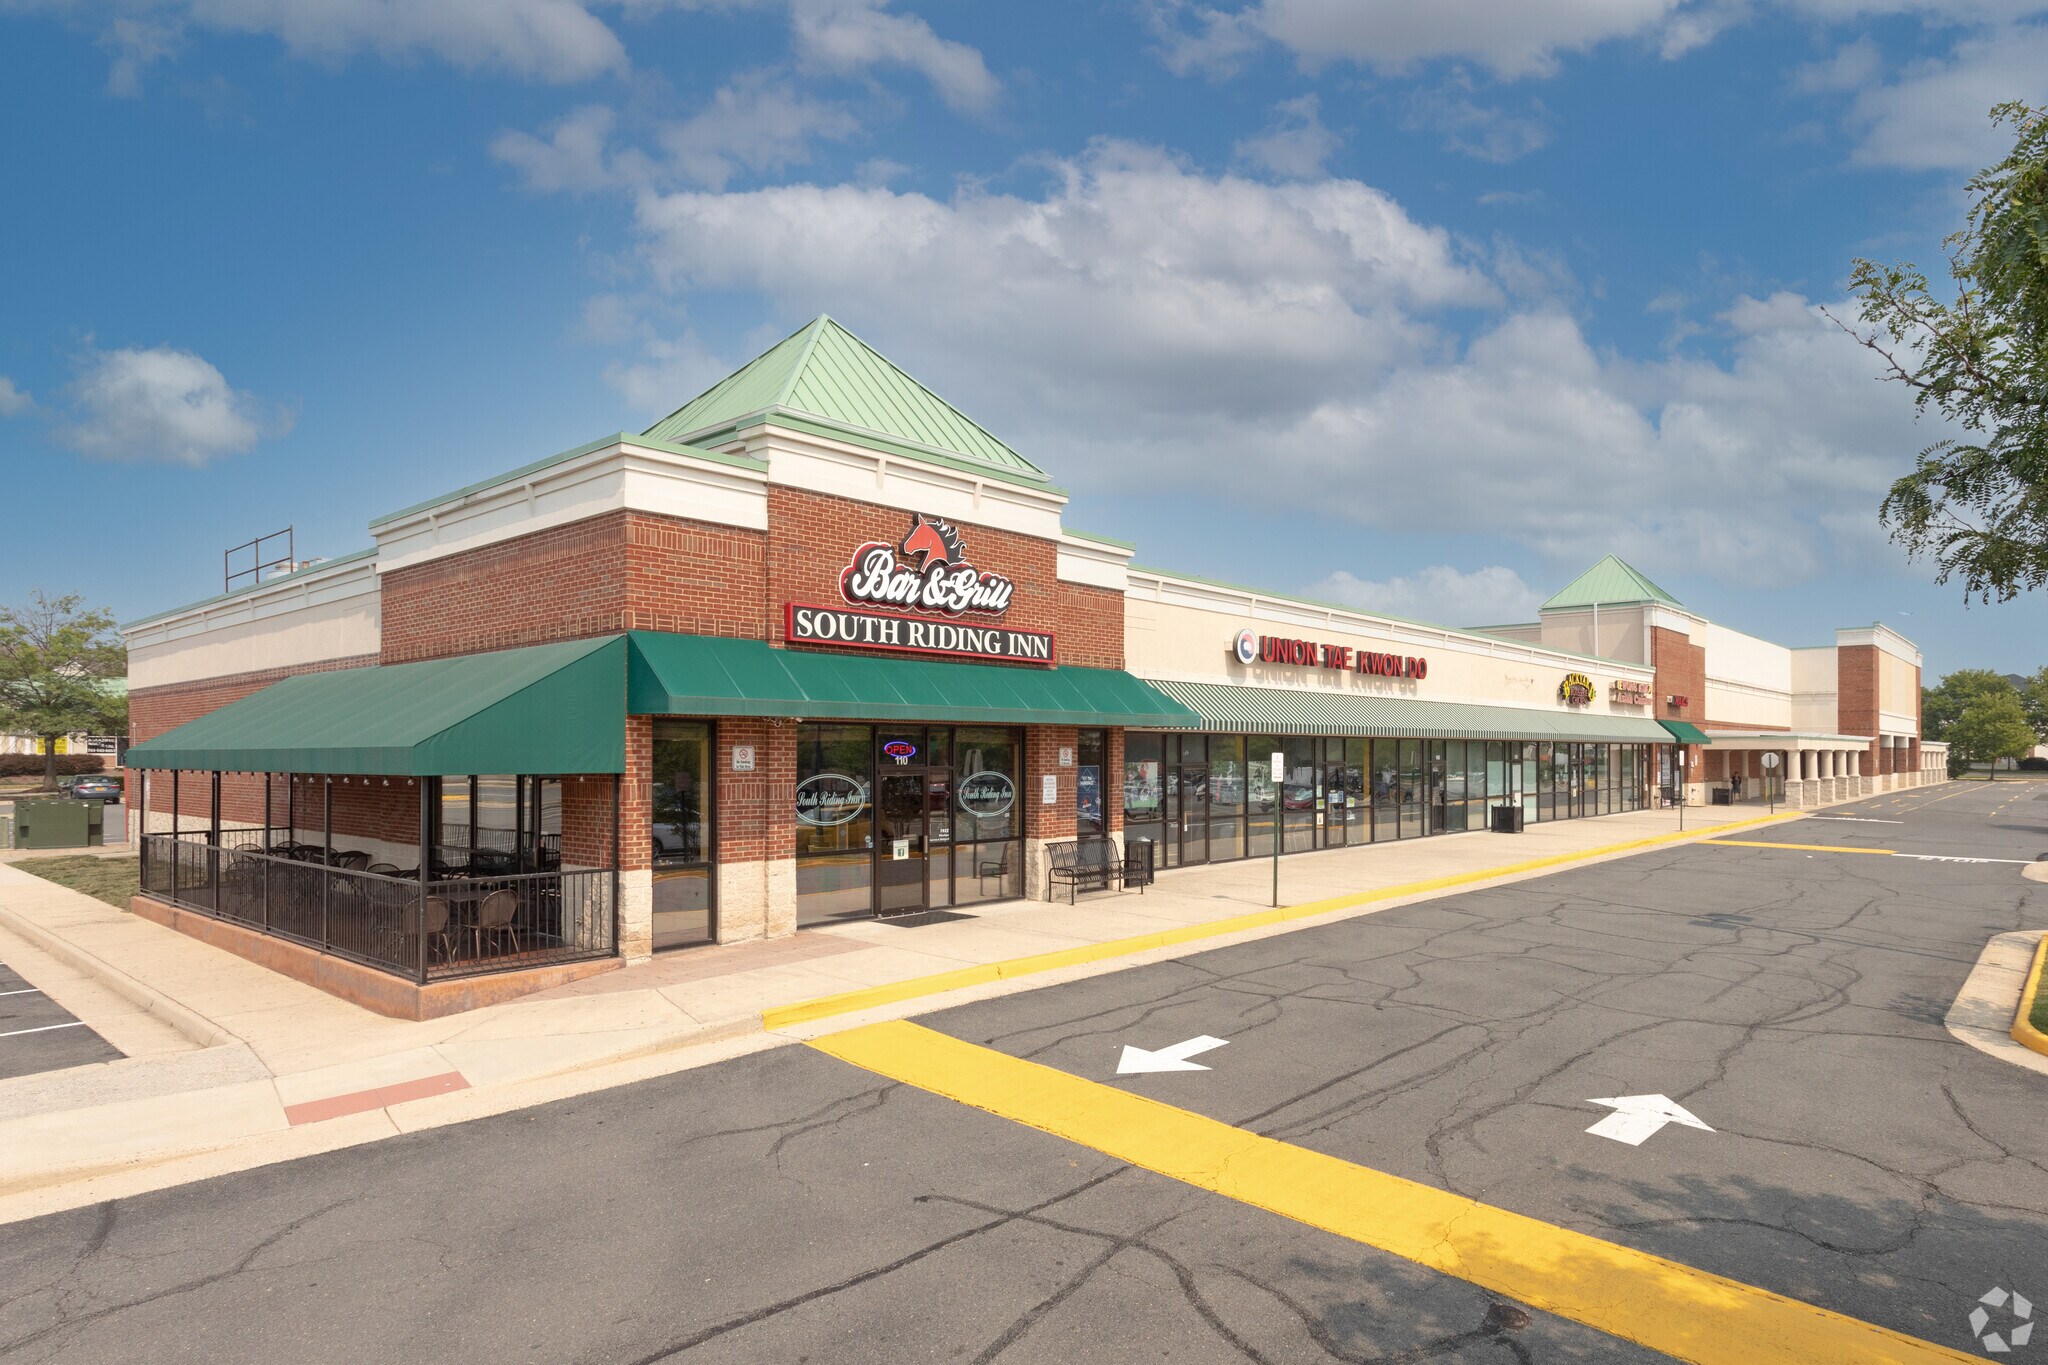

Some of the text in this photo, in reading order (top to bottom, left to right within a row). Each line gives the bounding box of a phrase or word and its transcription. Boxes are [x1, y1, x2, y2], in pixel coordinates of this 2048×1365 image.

[852, 549, 921, 601] Bar
[796, 609, 1049, 659] SOUTH RIDING INN
[1259, 635, 1427, 680] UNION TAE KWON DO
[885, 745, 913, 755] OPEN
[895, 756, 908, 765] 110
[819, 790, 845, 810] Riding
